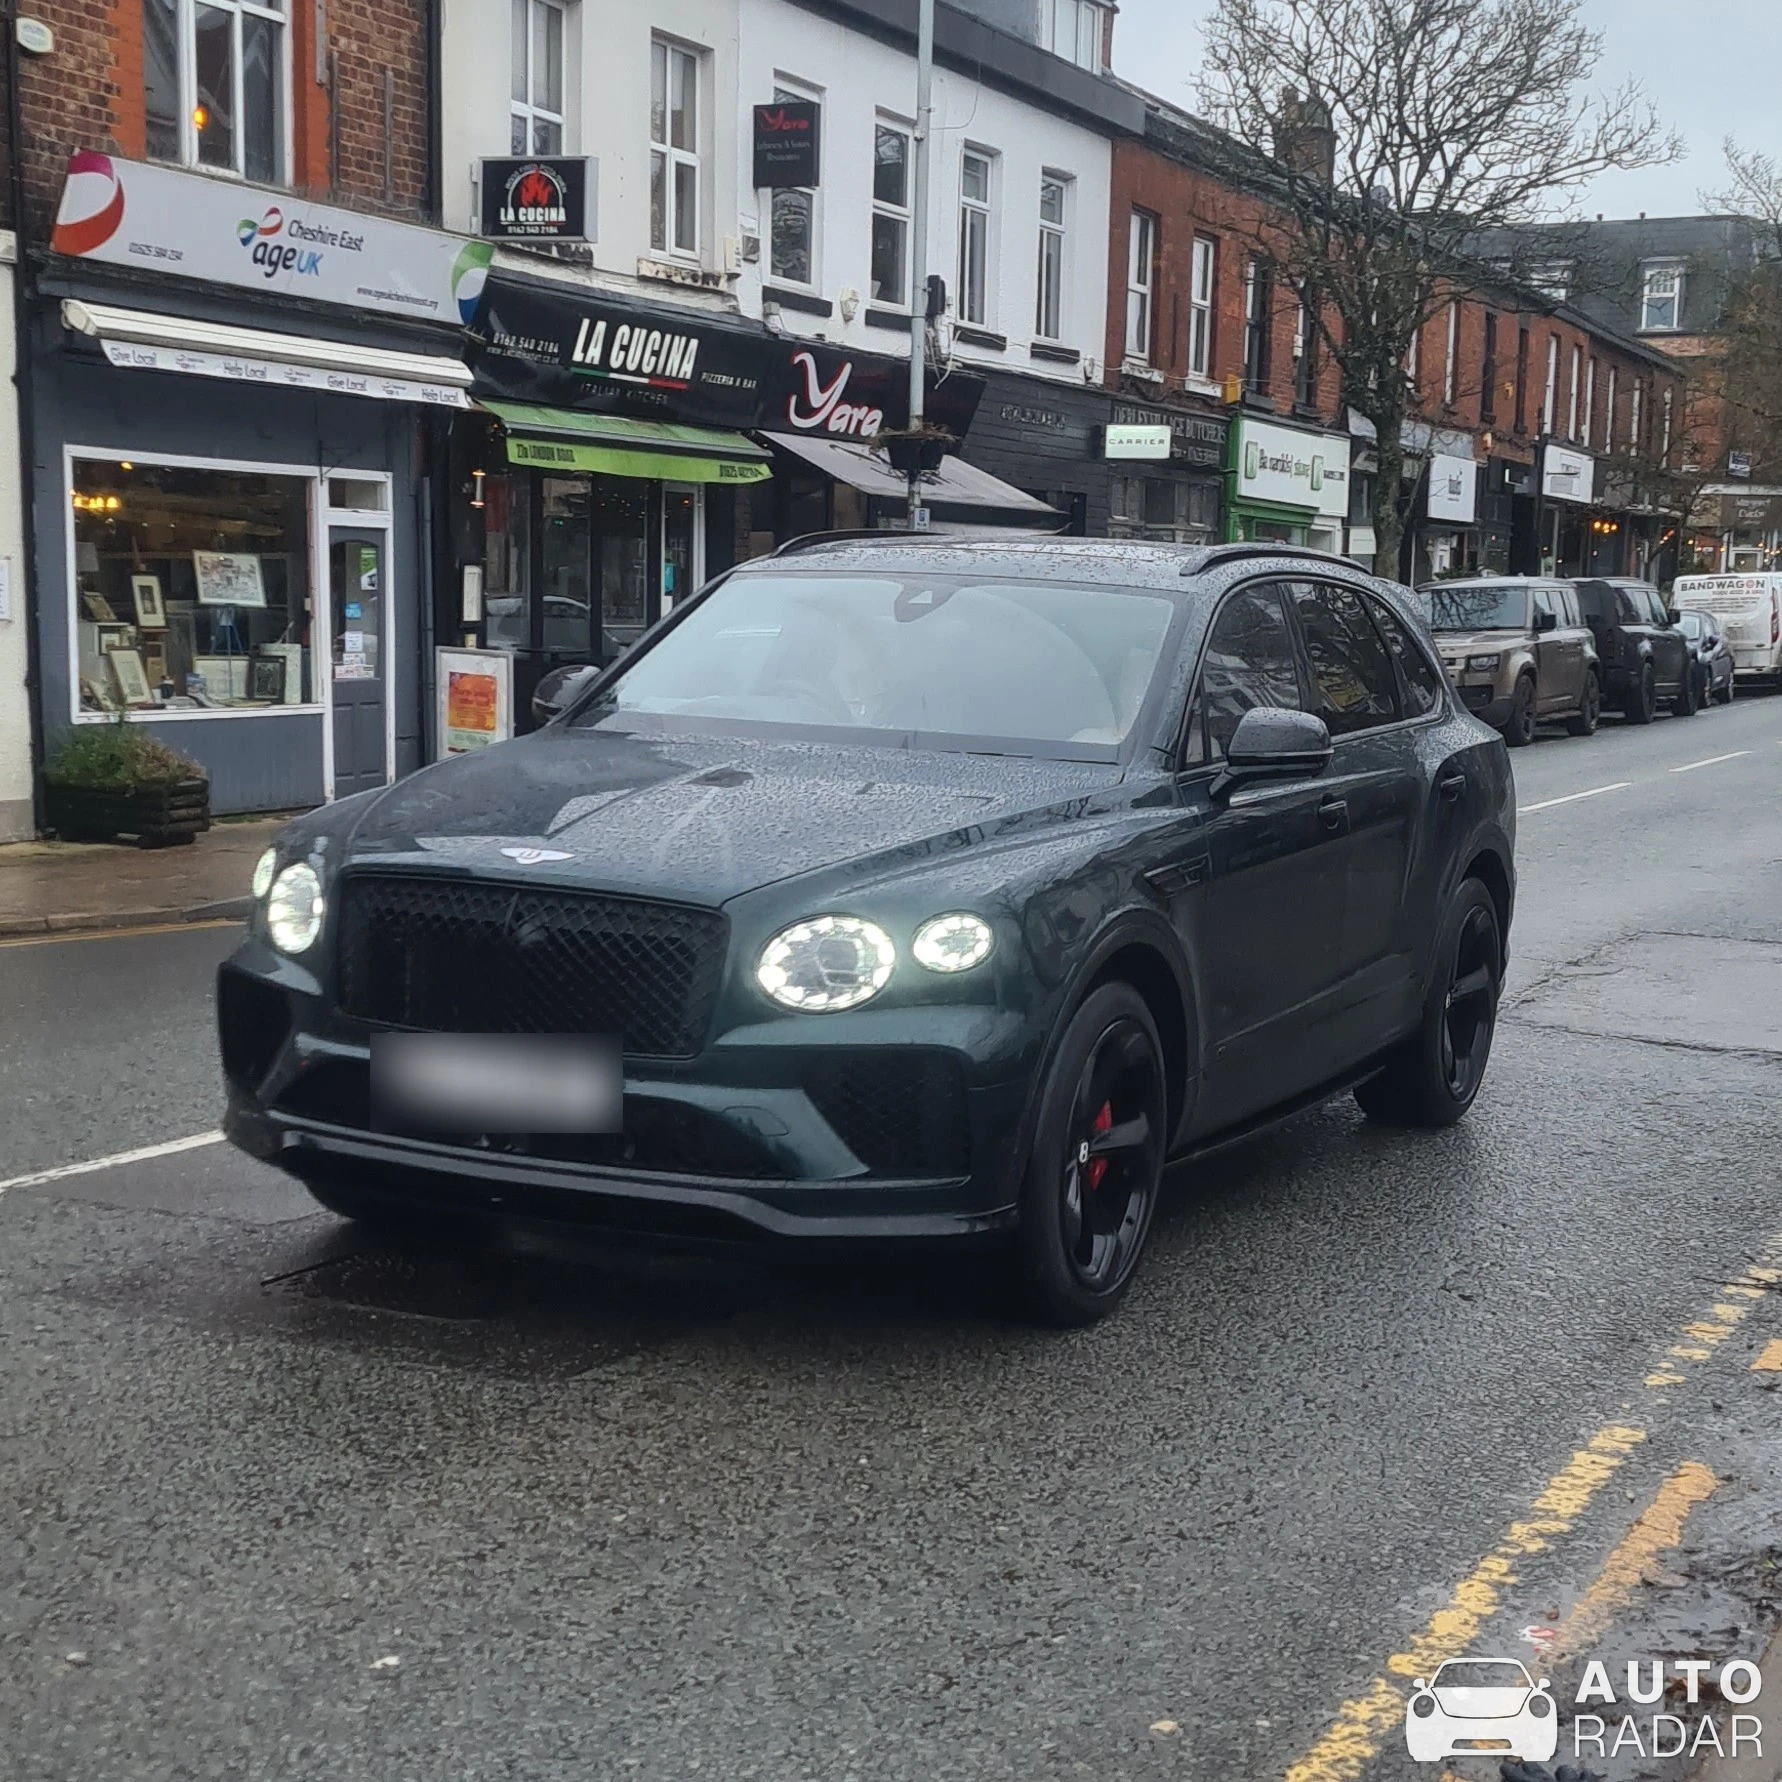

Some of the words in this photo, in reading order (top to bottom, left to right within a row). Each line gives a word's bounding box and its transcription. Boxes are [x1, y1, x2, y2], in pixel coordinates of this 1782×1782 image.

[500, 207, 515, 222] LA
[518, 207, 566, 222] CUCINA
[288, 220, 338, 247] Cheshire
[339, 231, 364, 251] East
[572, 318, 607, 365] LA
[609, 324, 699, 380] CUCINA
[244, 364, 267, 379] Local
[701, 372, 734, 385] PIZZERIA
[742, 379, 757, 389] BAR
[788, 350, 883, 438] Yara
[1108, 438, 1165, 446] CARRIER
